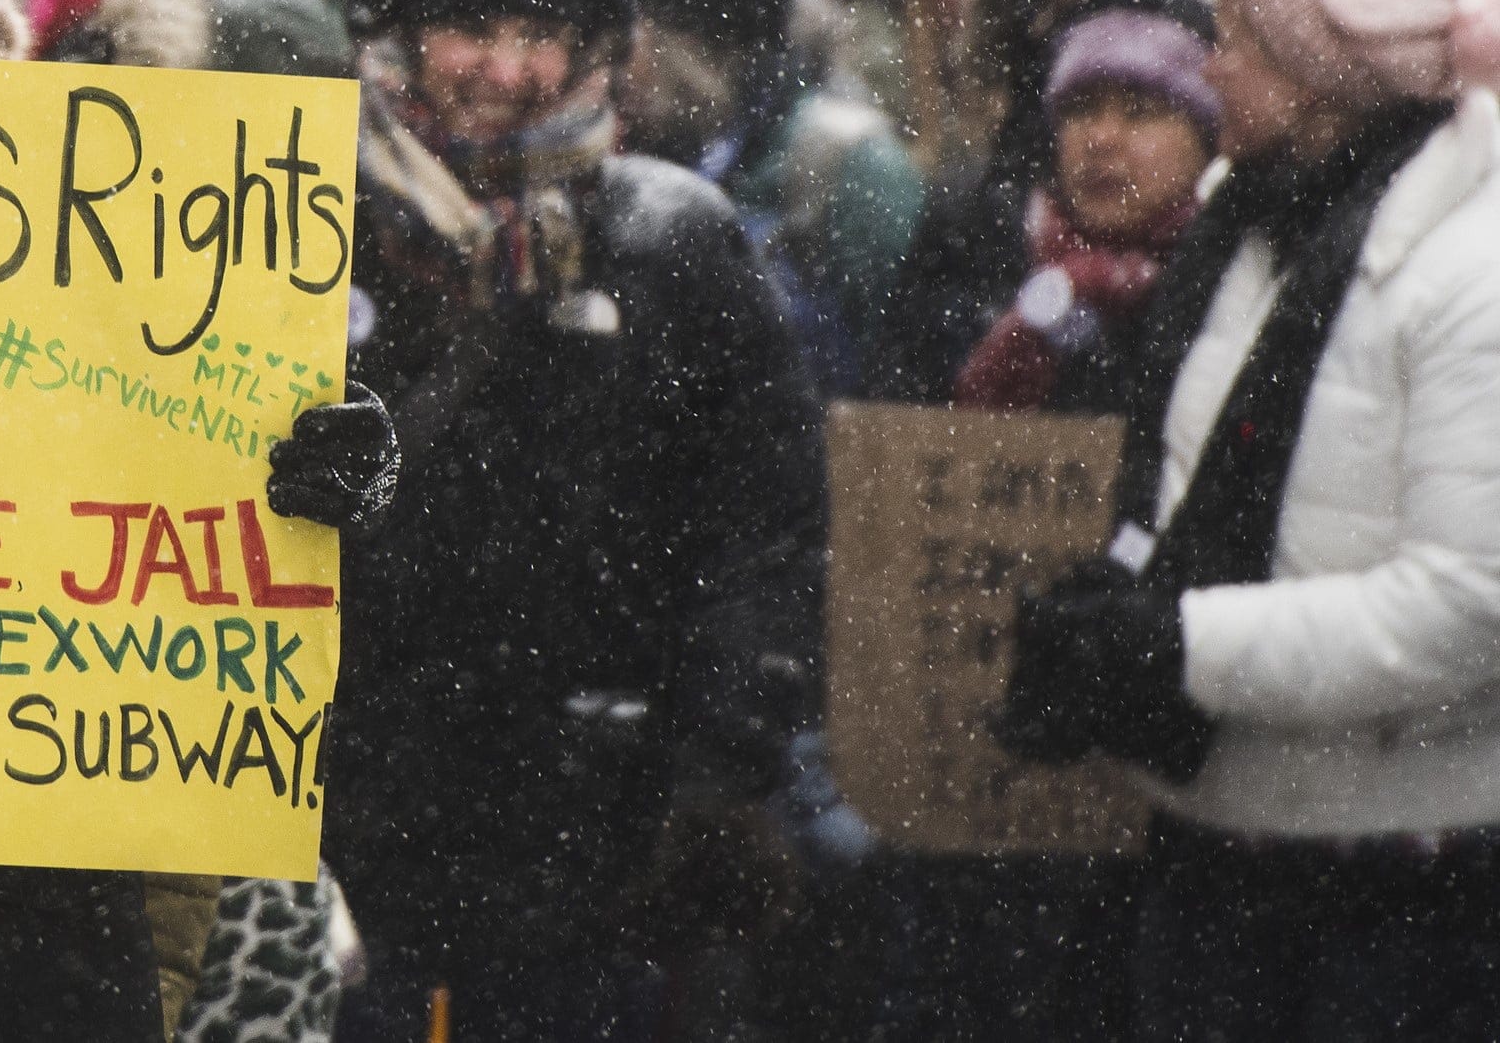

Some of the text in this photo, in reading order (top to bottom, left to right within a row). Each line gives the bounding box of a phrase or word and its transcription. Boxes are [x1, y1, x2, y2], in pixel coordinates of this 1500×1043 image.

[53, 86, 349, 356] Rights
[194, 353, 331, 419] MTL-T
[60, 499, 342, 615] JAIL,
[4, 693, 335, 810] SUBWAY!
